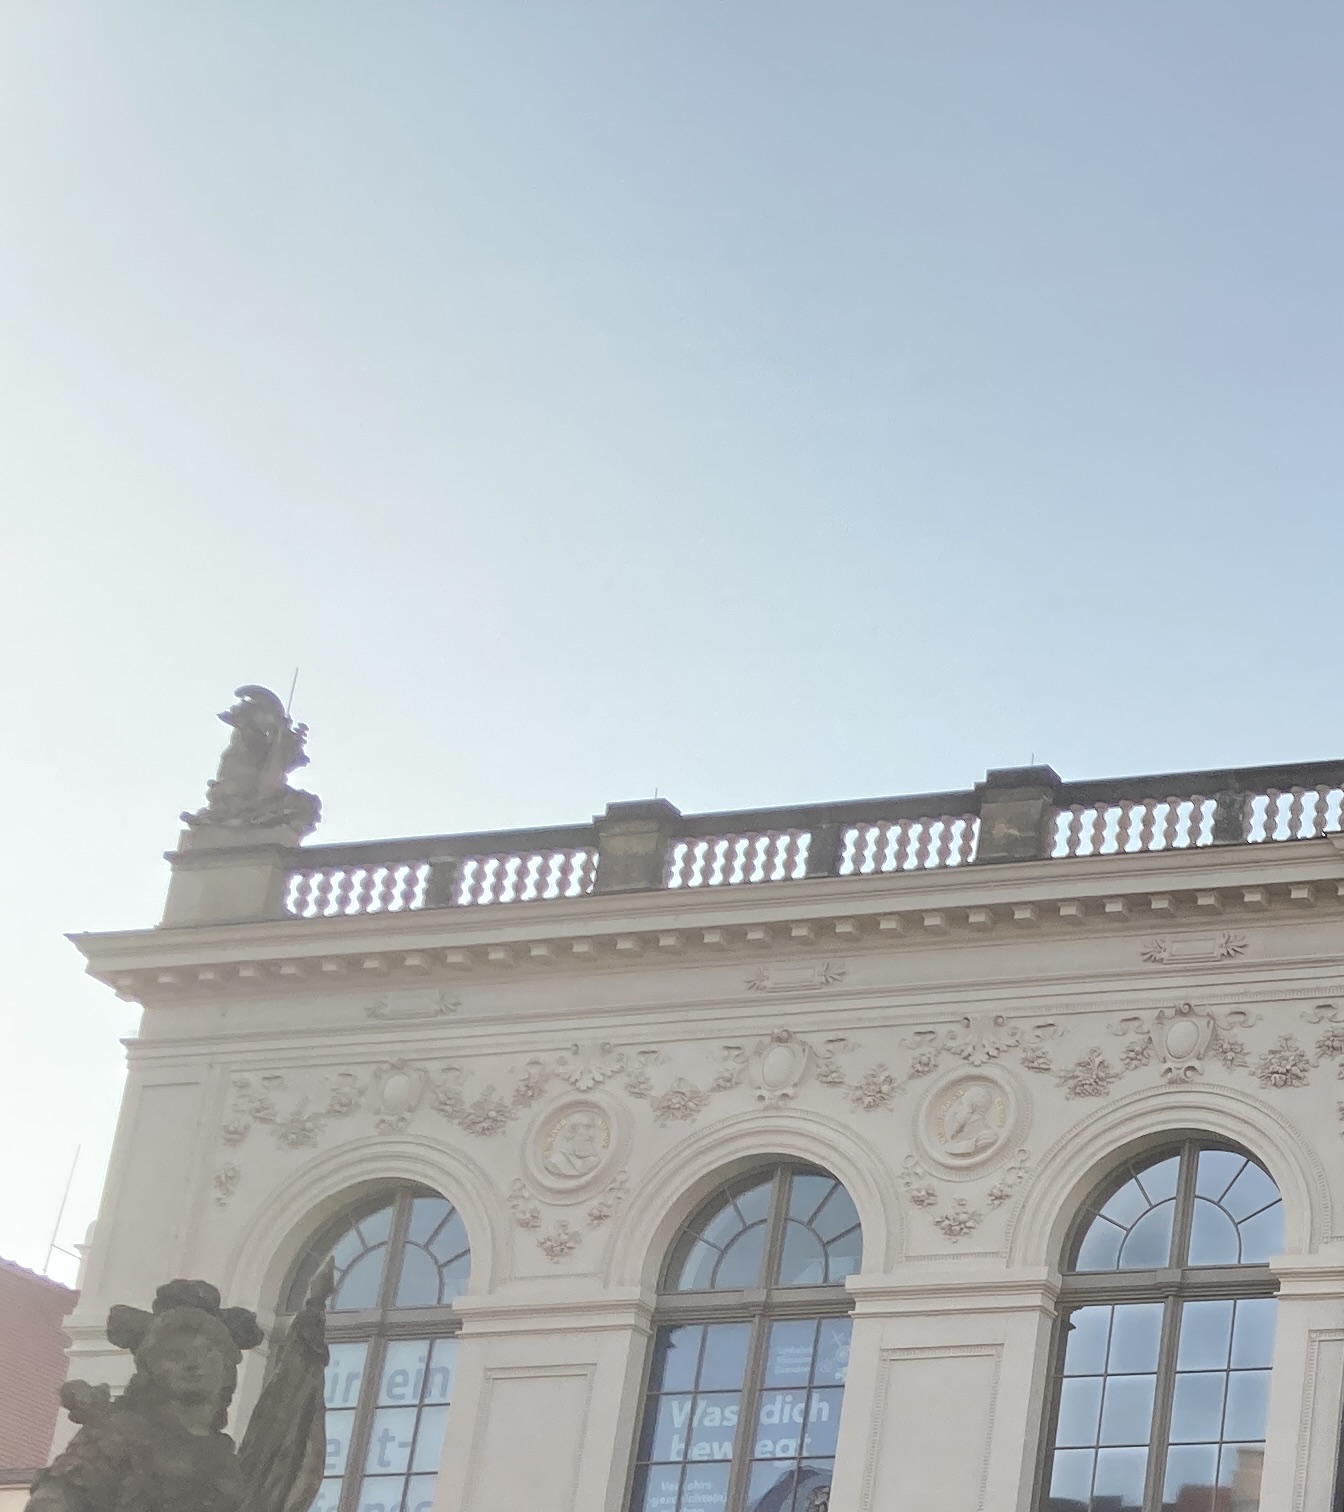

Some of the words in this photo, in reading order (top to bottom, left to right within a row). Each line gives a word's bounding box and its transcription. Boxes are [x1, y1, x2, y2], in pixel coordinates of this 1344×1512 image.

[386, 1355, 450, 1401] ein
[671, 1399, 740, 1428] Was
[760, 1393, 830, 1426] dich
[669, 1433, 812, 1468] bewegt
